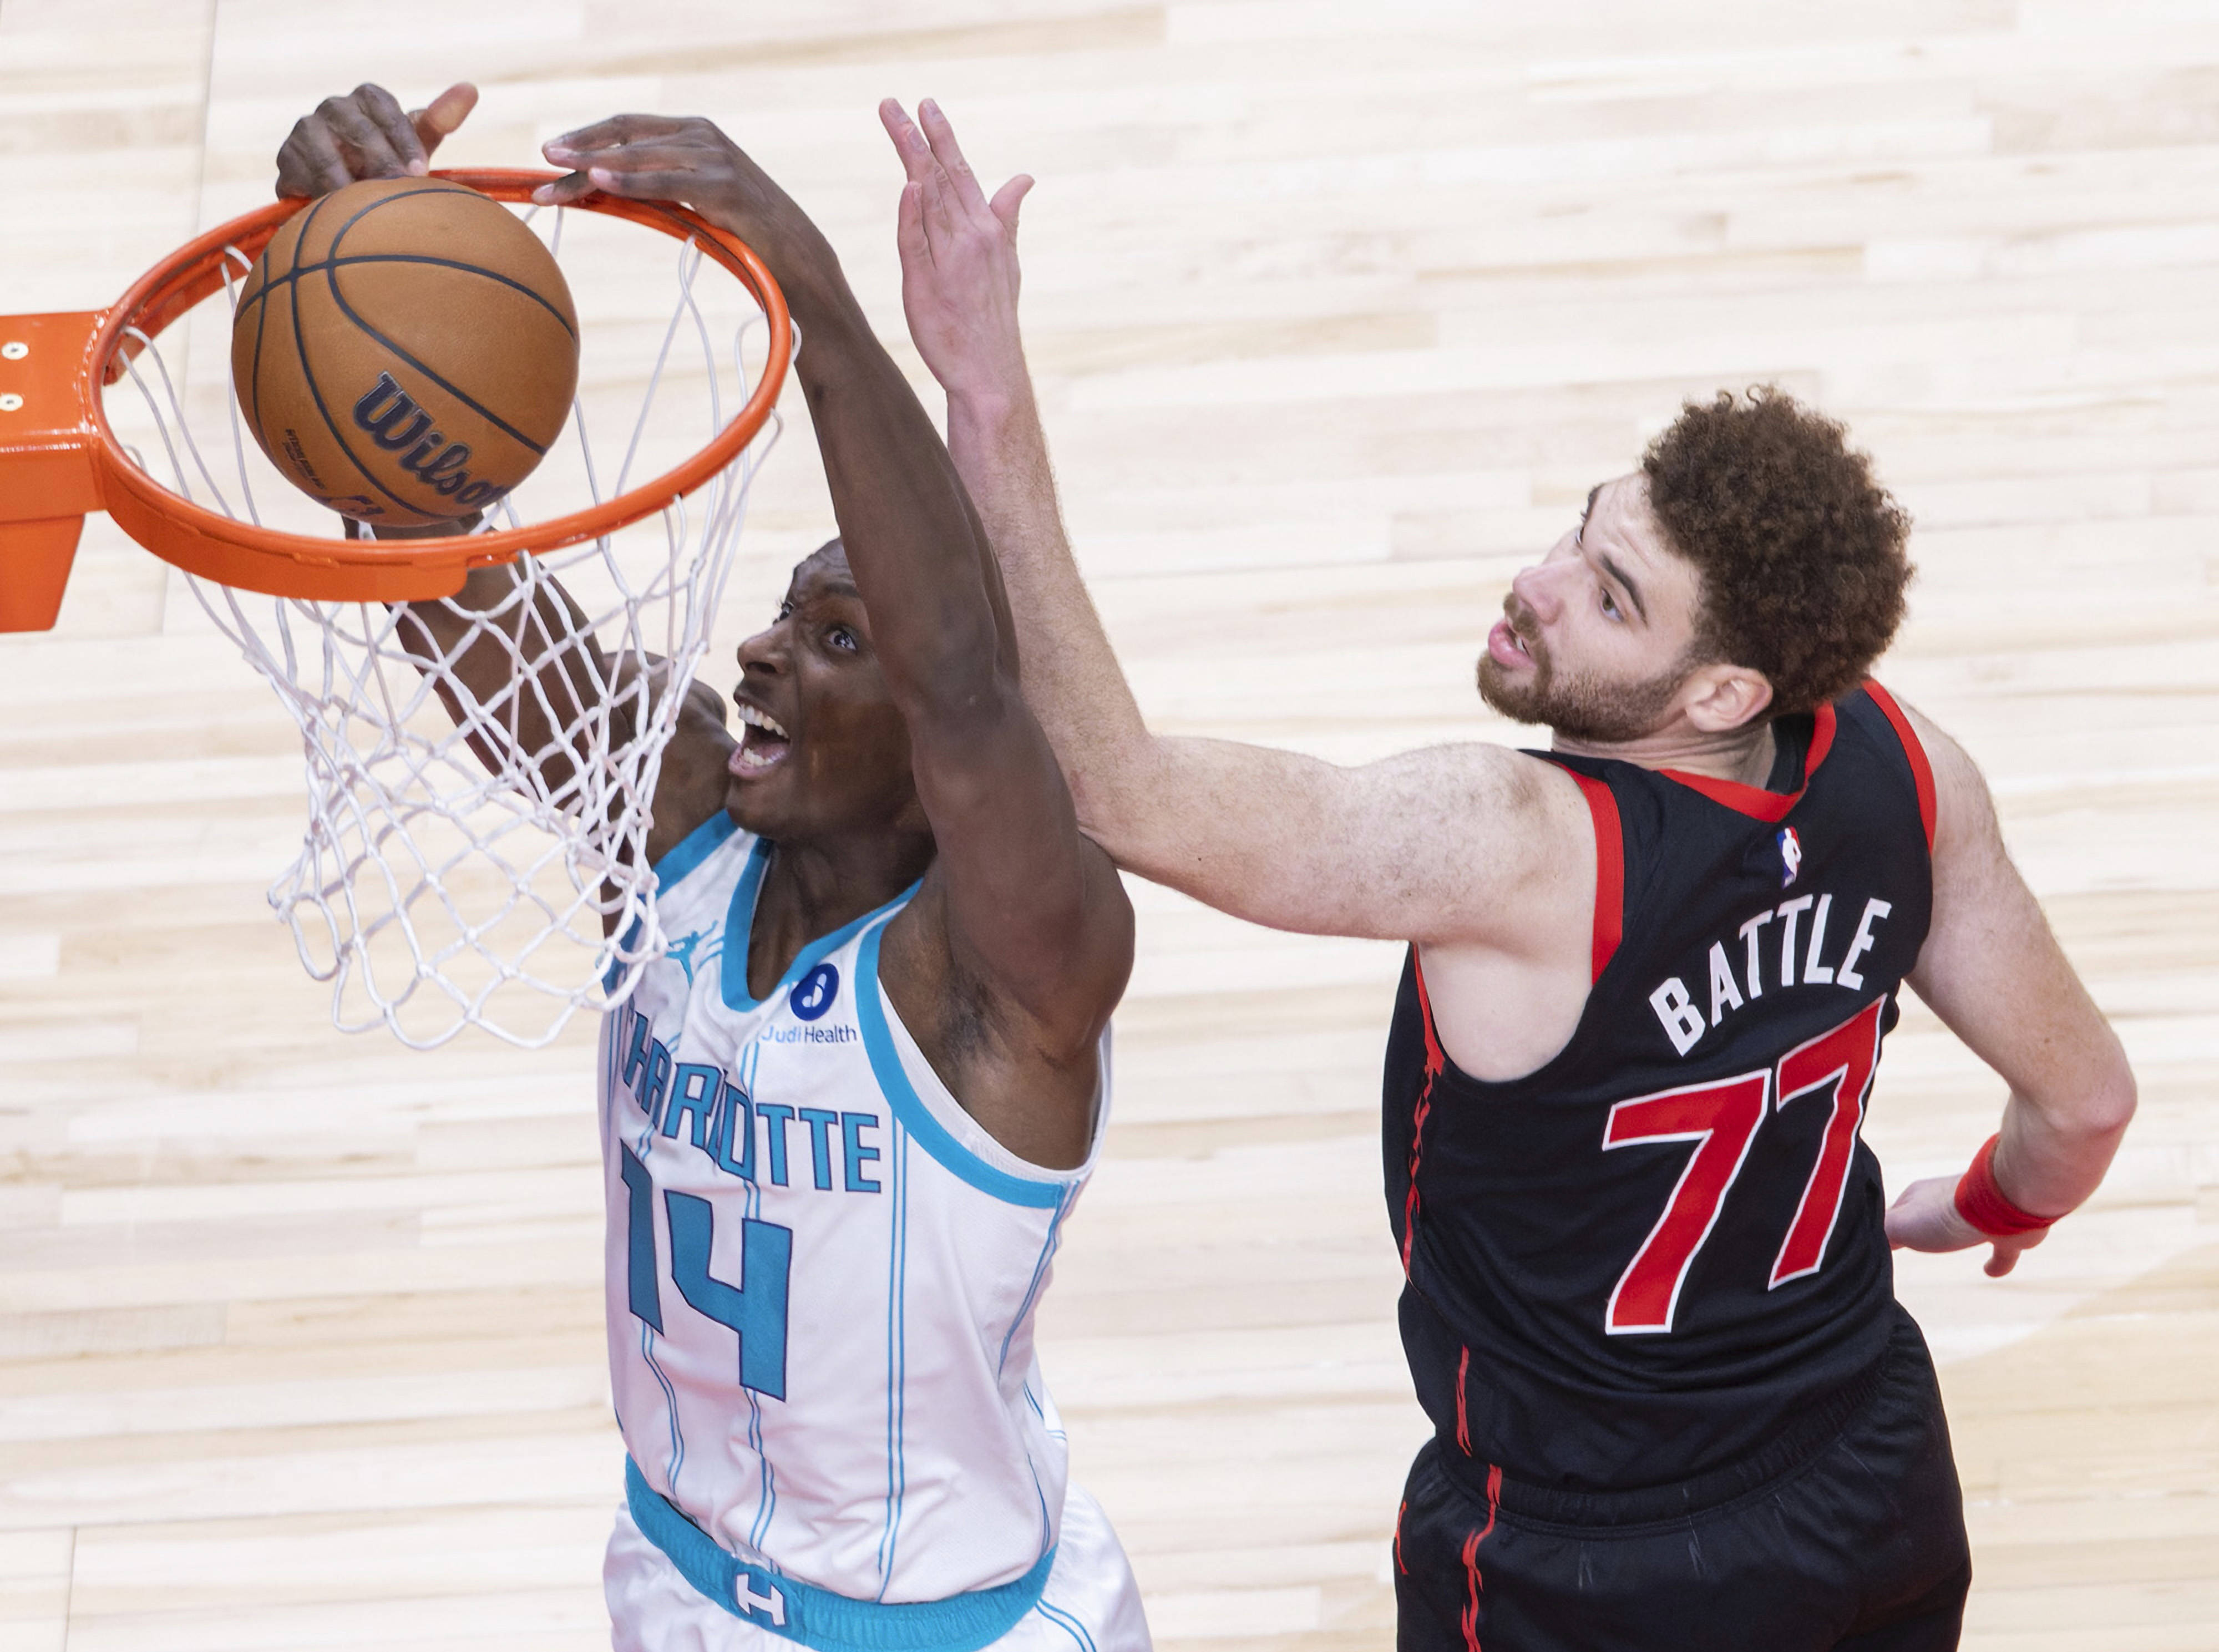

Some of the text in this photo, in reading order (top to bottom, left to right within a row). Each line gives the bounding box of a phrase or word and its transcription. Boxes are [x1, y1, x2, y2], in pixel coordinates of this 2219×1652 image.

[804, 1025, 857, 1044] Health
[1649, 893, 1892, 1057] BATTLE
[622, 993, 882, 1194] HAROTTE
[1602, 993, 1887, 1335] 77
[621, 1137, 793, 1402] 14
